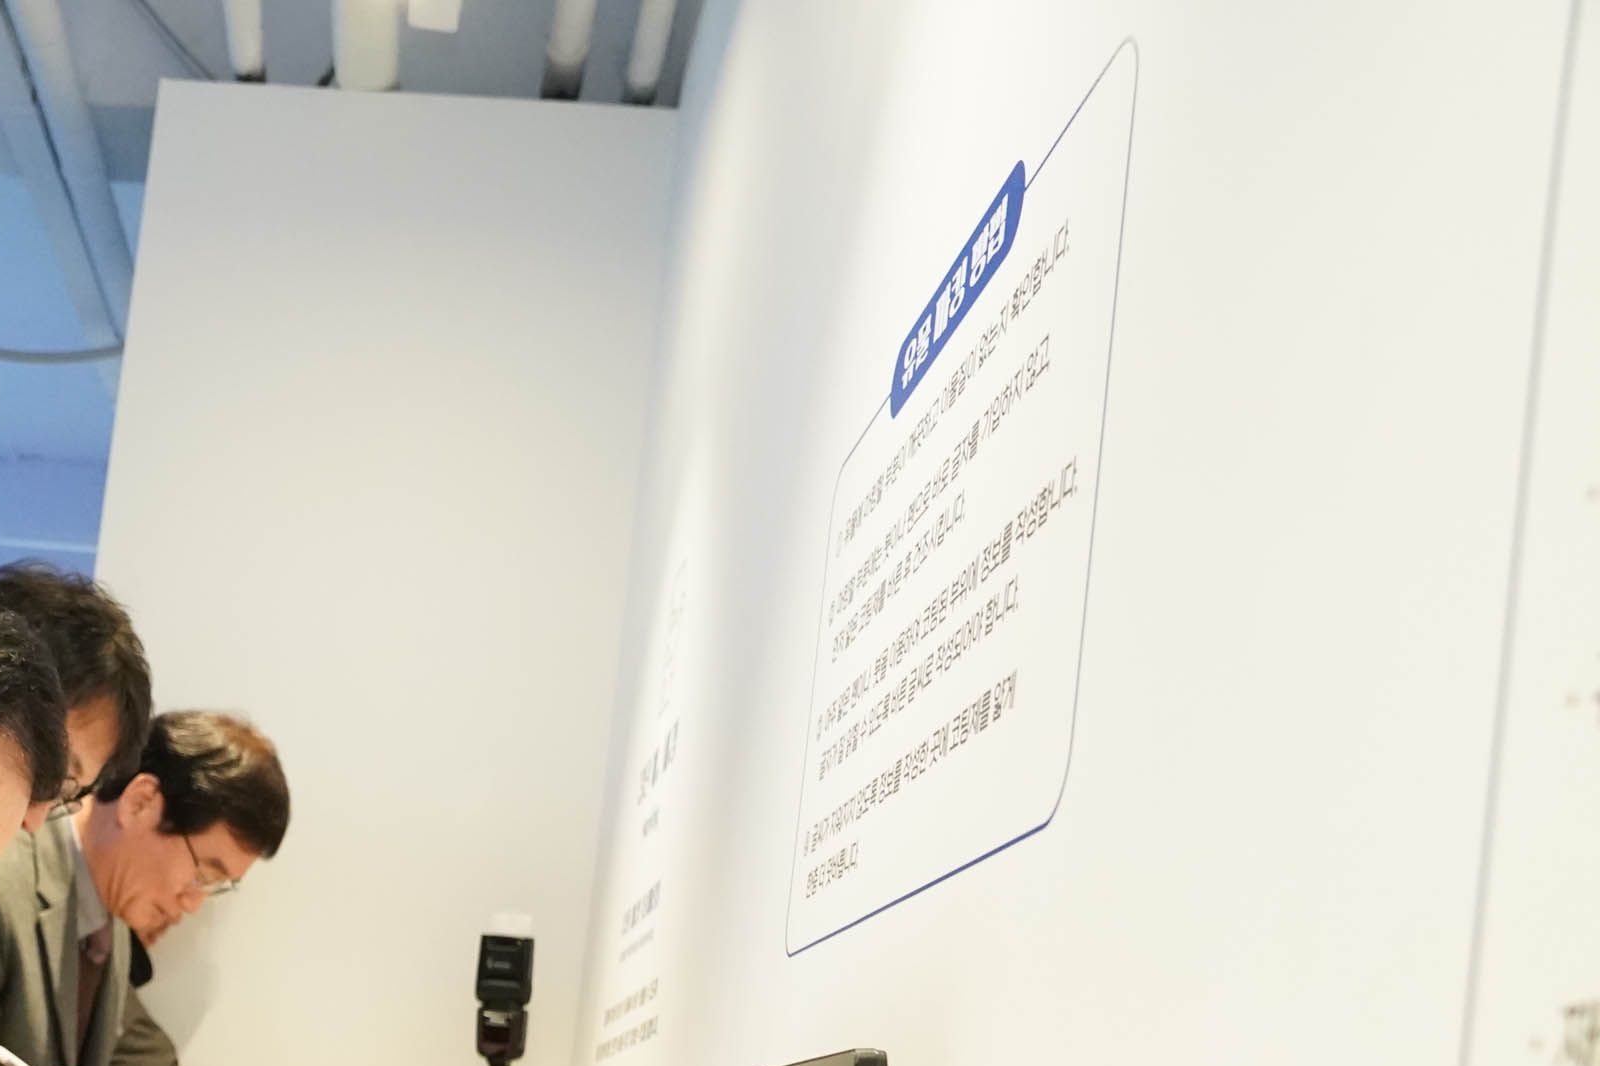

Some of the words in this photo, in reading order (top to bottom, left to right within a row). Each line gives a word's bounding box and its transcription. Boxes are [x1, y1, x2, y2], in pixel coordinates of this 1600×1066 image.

[900, 307, 932, 394] 유물
[968, 189, 1009, 294] 방법
[939, 342, 975, 422] 이물질이
[977, 296, 1009, 372] 없는지
[1010, 215, 1073, 329] 확인합니다.
[906, 476, 932, 536] 펜으로
[931, 452, 950, 506] 바로
[950, 416, 979, 483] 글자를
[980, 361, 1024, 448] 기입하지
[872, 645, 888, 689] 붓을
[888, 612, 920, 674] 이용하여
[920, 583, 949, 643] 코팅된
[949, 552, 979, 615] 부위에
[980, 517, 1013, 585] 정보를
[1013, 453, 1081, 553] 작성합니다.
[886, 557, 903, 605] 바른
[902, 546, 912, 587] 후
[912, 487, 967, 576] 건조시킵니다.
[855, 775, 878, 822] 않도록
[877, 756, 902, 806] 정보를
[901, 735, 929, 788] 작성한
[929, 719, 950, 768] 곳에
[948, 686, 991, 754] 코팅제를
[992, 666, 1017, 723] 얇게
[858, 711, 867, 748] 수
[867, 690, 890, 740] 있도록
[890, 675, 907, 720] 바른
[907, 649, 934, 705] 글씨로
[934, 603, 984, 682] 작성되어야
[984, 572, 1021, 638] 합니다.
[817, 860, 825, 893] 더
